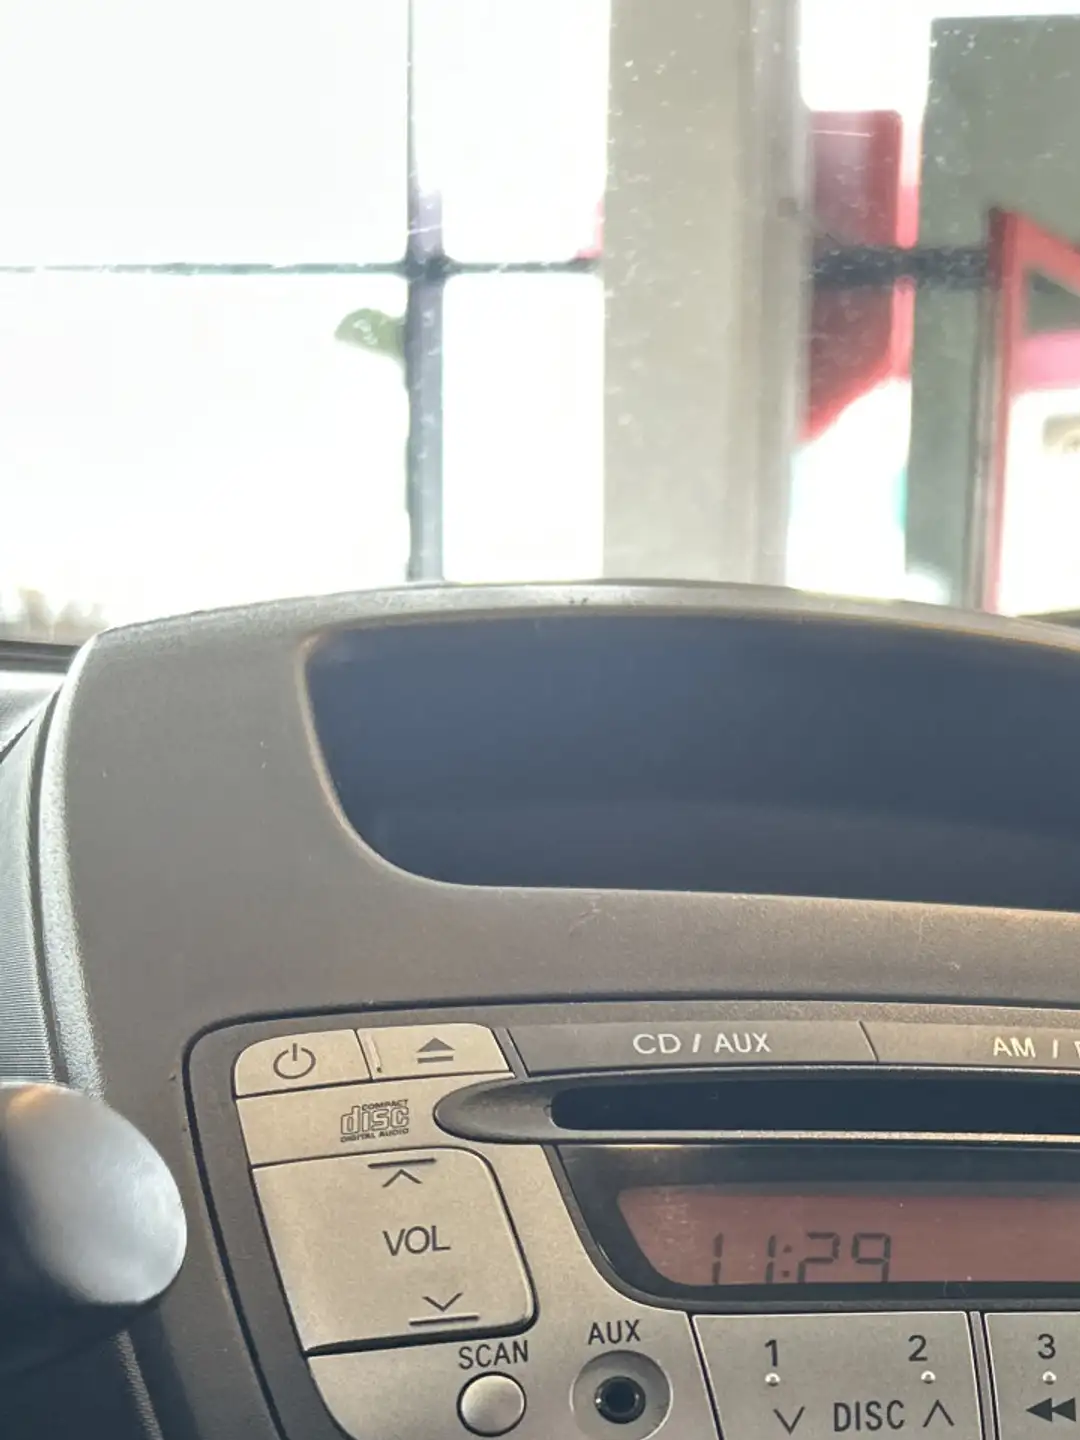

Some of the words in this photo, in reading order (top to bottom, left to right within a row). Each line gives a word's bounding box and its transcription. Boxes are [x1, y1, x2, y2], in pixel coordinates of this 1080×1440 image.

[633, 1032, 681, 1055] CD
[713, 1032, 772, 1054] AUX
[992, 1037, 1036, 1058] AM
[383, 1225, 451, 1256] VOL
[711, 1231, 892, 1285] 11:29
[587, 1319, 642, 1345] AUX
[458, 1340, 529, 1370] SCAN
[764, 1339, 778, 1367] 1
[908, 1335, 928, 1362] 2
[1037, 1334, 1057, 1359] 3
[833, 1399, 905, 1433] DISC
